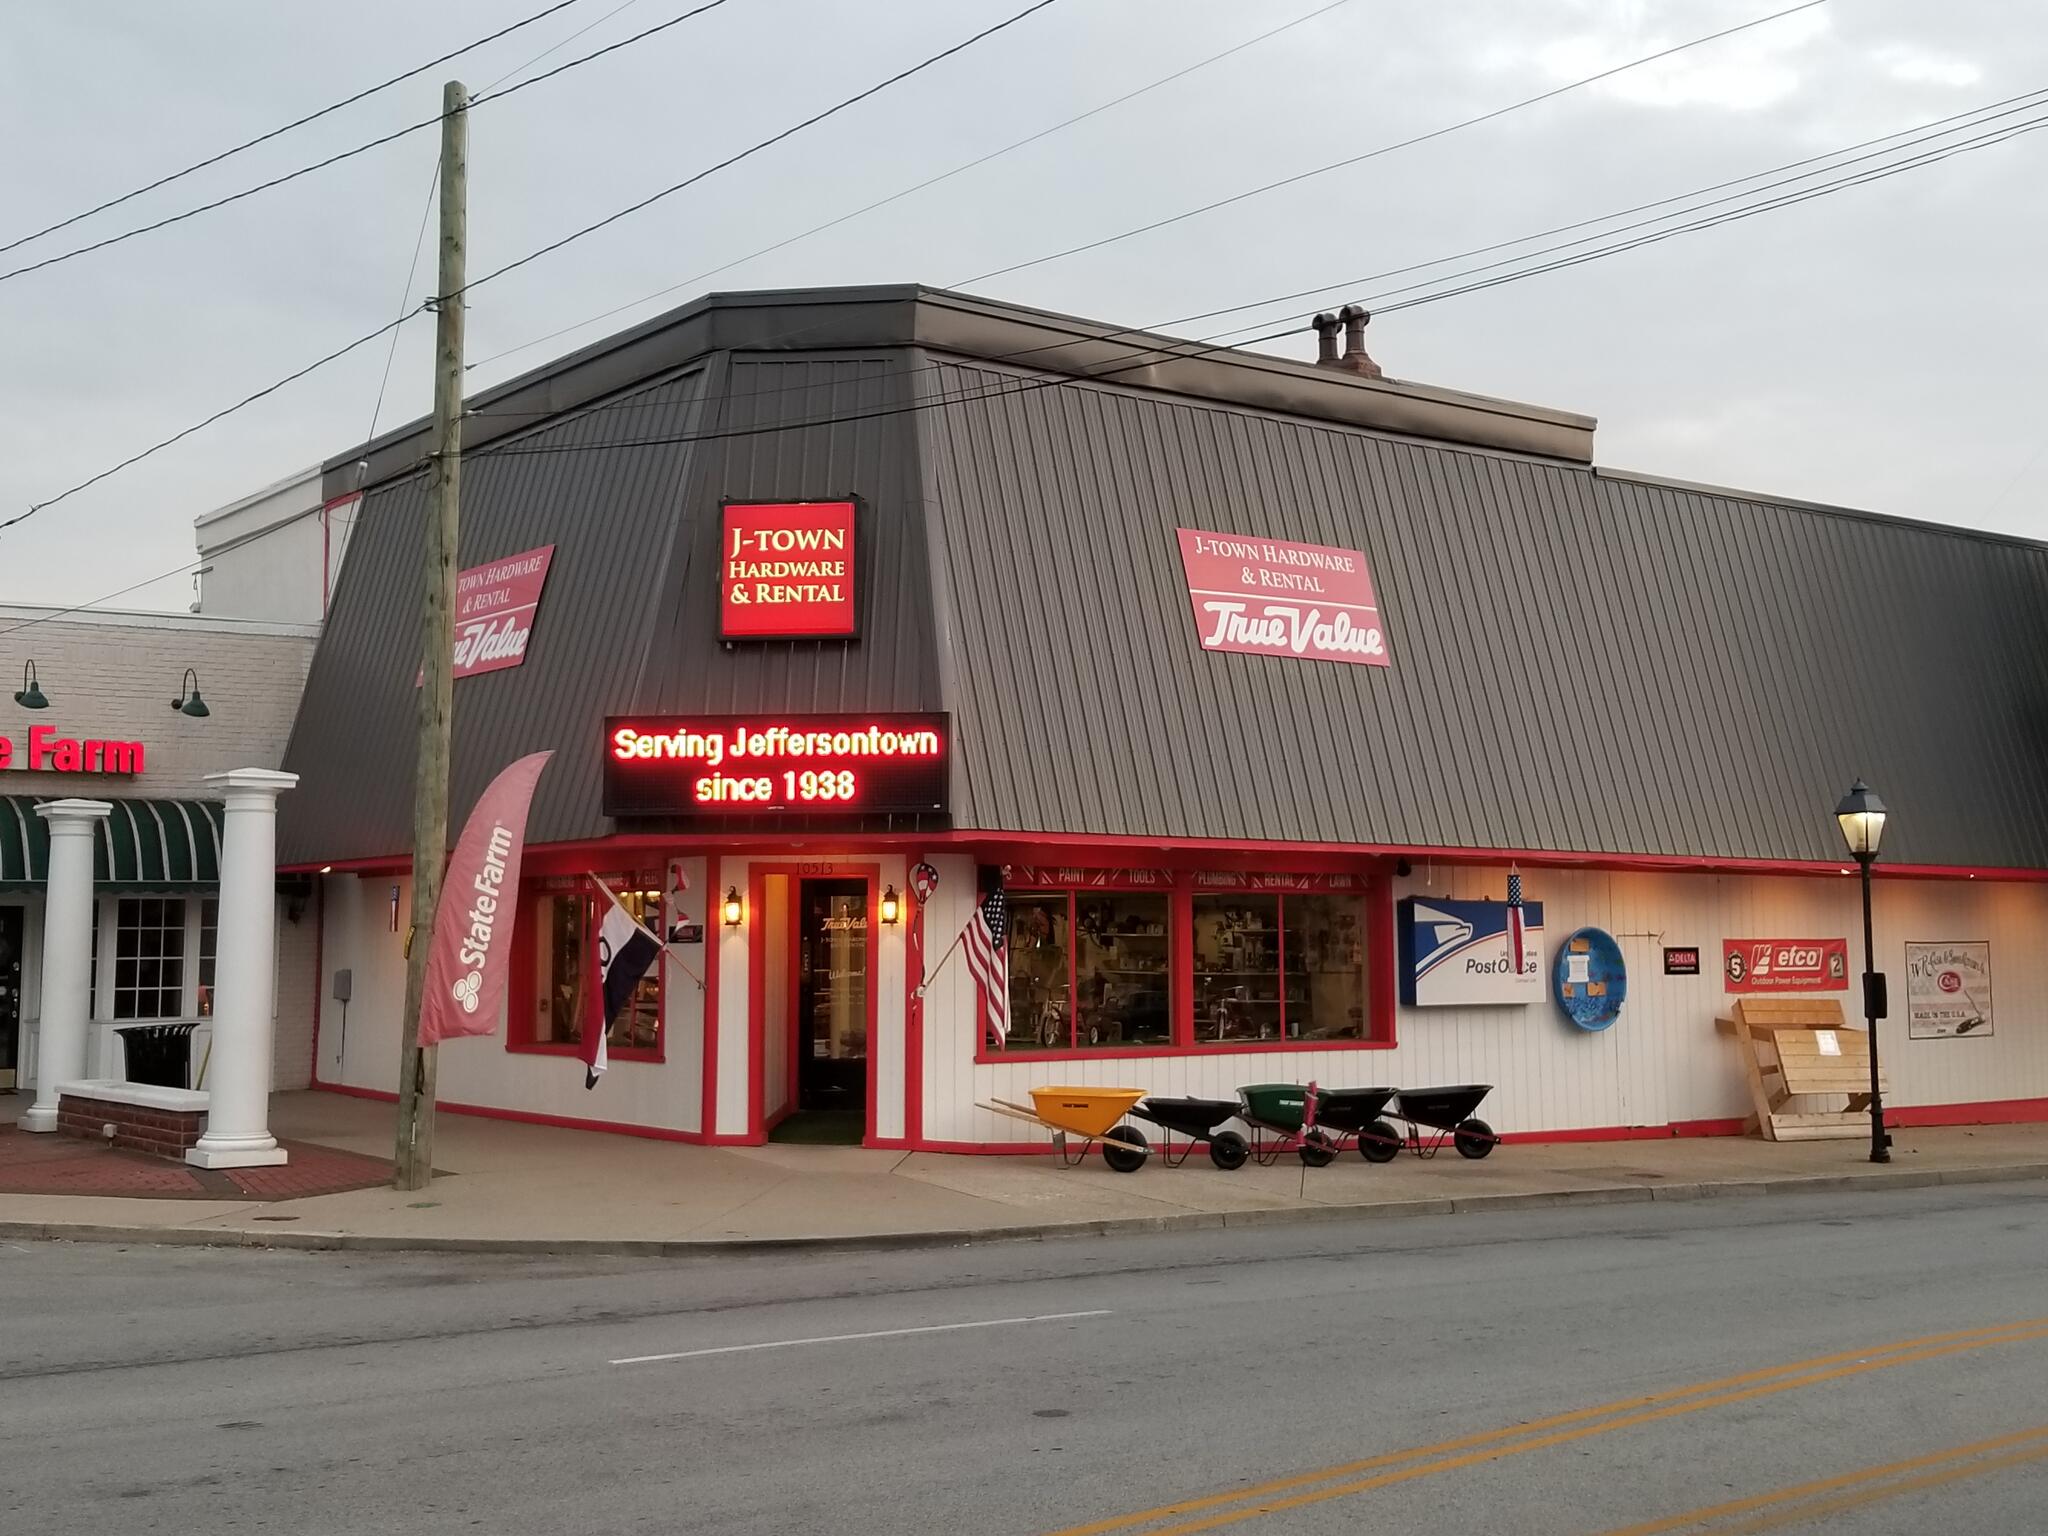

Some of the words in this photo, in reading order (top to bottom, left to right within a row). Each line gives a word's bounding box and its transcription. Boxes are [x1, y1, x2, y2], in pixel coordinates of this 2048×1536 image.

[731, 527, 845, 557] J-TOWN
[1195, 536, 1260, 561] J-TOWN
[1262, 544, 1355, 573] HARDWARE
[458, 571, 484, 593] TOWN
[485, 555, 543, 585] HARDWARE
[729, 560, 845, 578] HARDWARE
[1241, 567, 1256, 585] &
[1259, 569, 1325, 593] RENTAL
[462, 597, 472, 613] &
[473, 587, 511, 611] RENTAL
[730, 583, 751, 604] &
[755, 583, 845, 603] RENTAL
[28, 725, 145, 774] Farm
[614, 728, 724, 765] Serving
[729, 725, 938, 758] Jeffersontown
[695, 771, 772, 801] since
[784, 770, 855, 801] 1938
[796, 862, 833, 876] 10513
[1058, 868, 1085, 883] PAINT
[1129, 869, 1156, 884] TOOLS
[1264, 873, 1295, 887] RENTAL
[1465, 958, 1497, 974] Post
[1778, 945, 1818, 966] efco
[1731, 957, 1741, 976] 5
